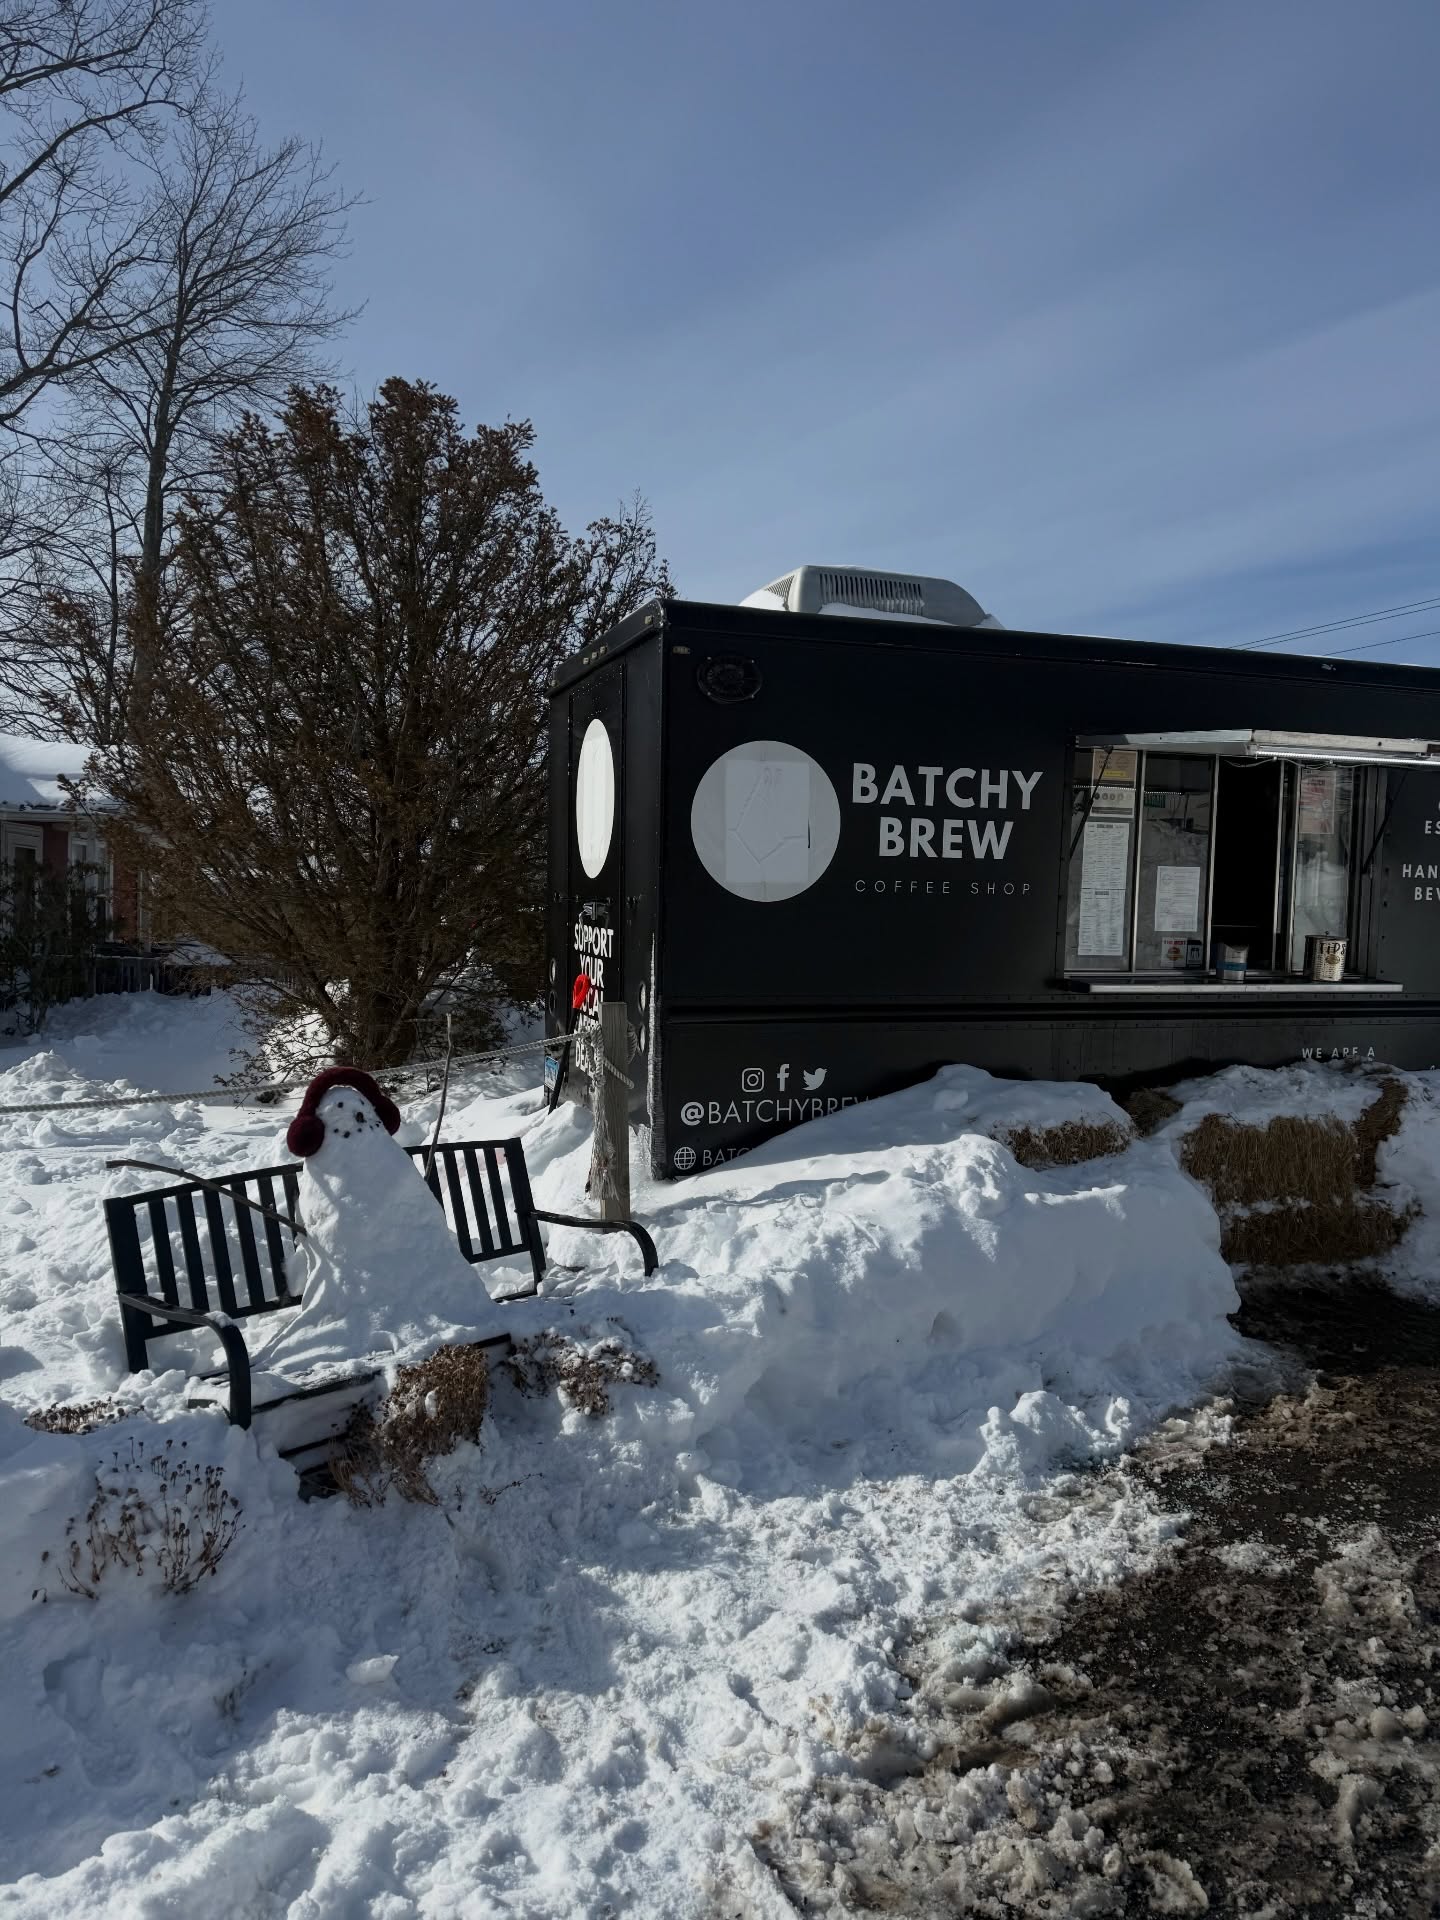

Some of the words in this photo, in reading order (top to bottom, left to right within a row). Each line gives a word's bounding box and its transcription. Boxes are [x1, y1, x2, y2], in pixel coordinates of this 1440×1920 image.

[852, 762, 1044, 810] BATCHY
[879, 816, 1014, 860] BREW
[855, 879, 950, 895] COFFEE
[970, 882, 1030, 897] SHOP
[573, 923, 614, 958] SUPPORT
[579, 953, 606, 989] YOUR
[573, 985, 604, 1016] OCAL
[1302, 1047, 1322, 1059] WE
[1332, 1046, 1359, 1058] ARE
[1367, 1046, 1376, 1057] A
[681, 1096, 869, 1126] @BATCHYBRE
